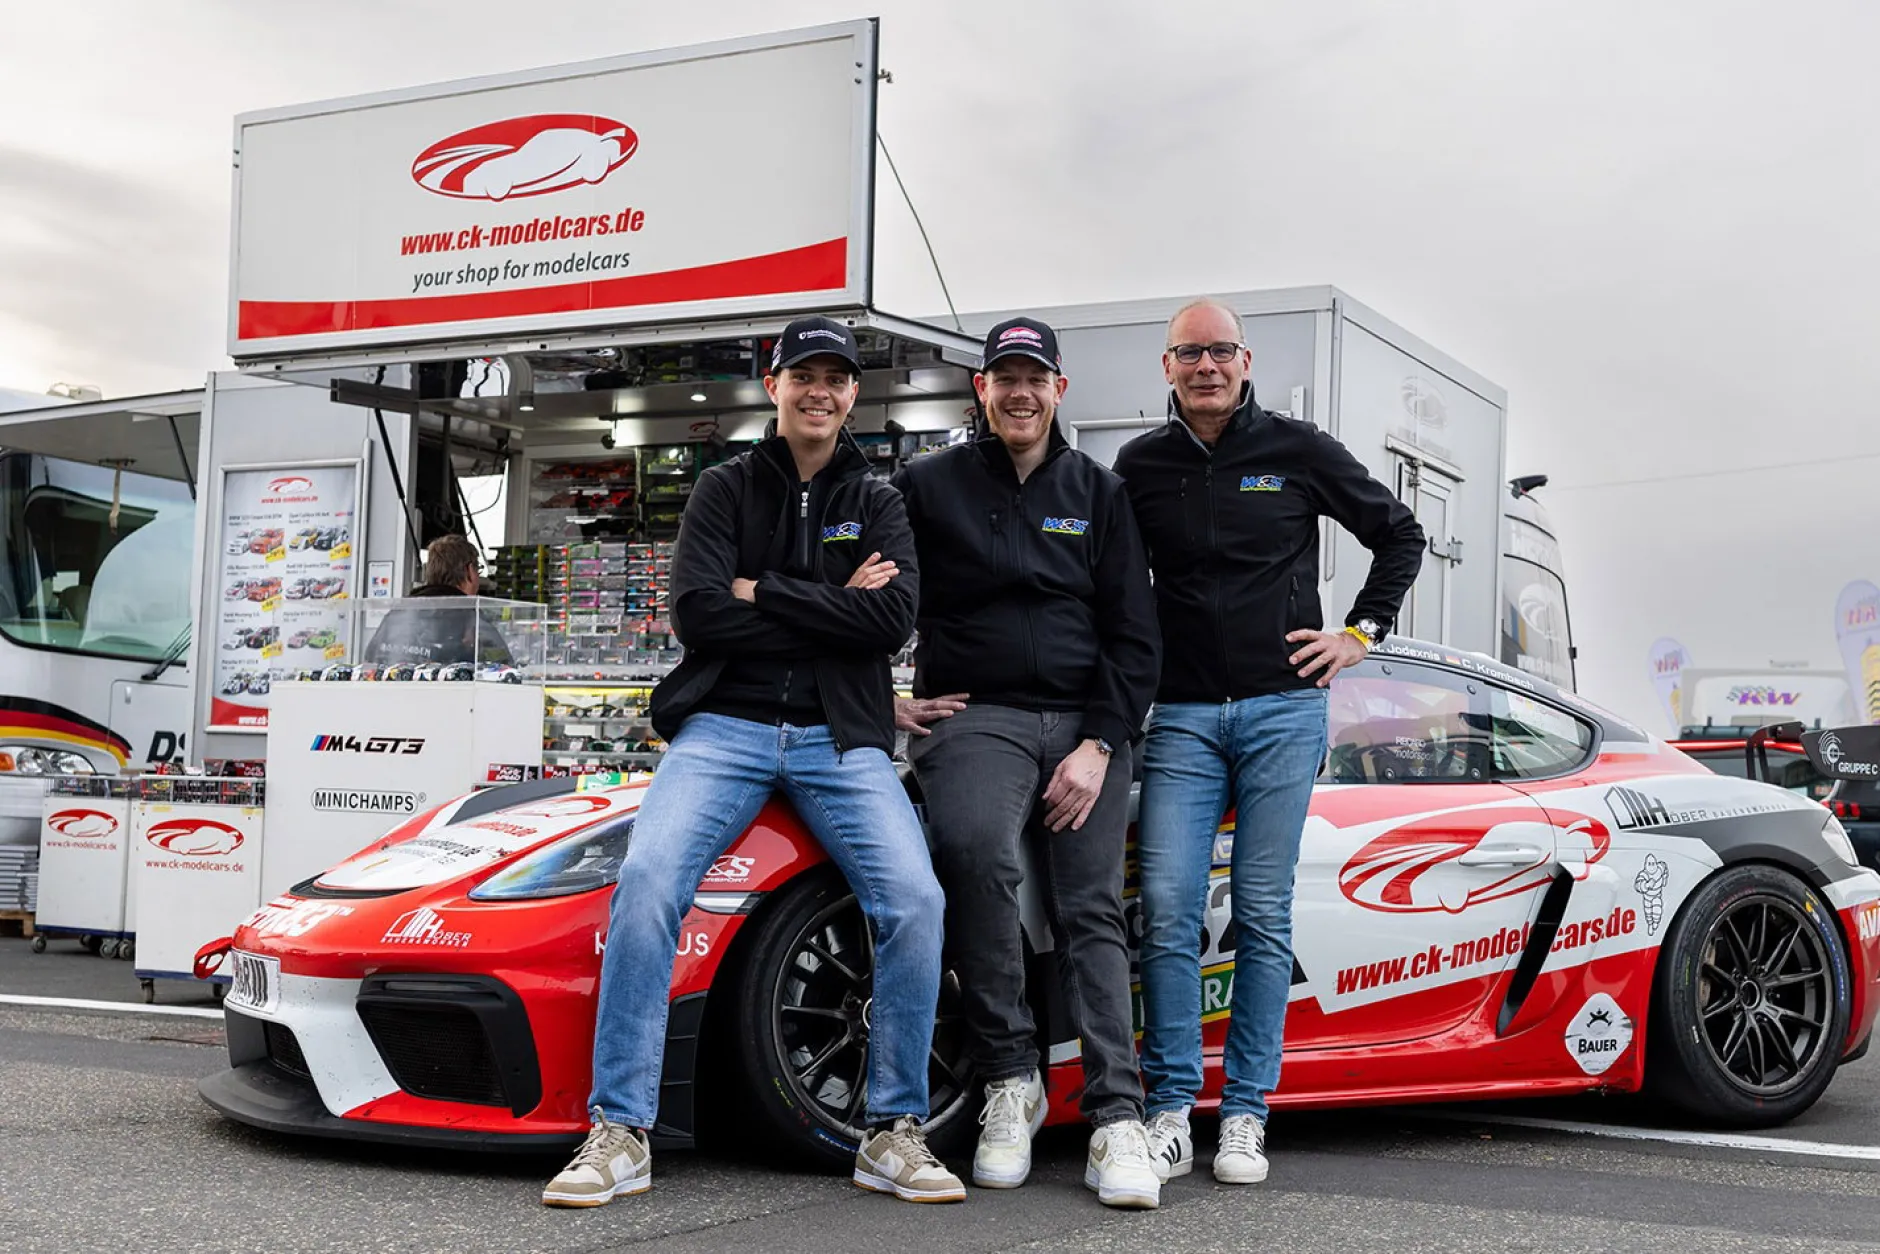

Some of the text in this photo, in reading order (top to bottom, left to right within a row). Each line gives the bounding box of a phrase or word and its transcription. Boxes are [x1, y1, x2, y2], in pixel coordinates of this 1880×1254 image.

[401, 209, 645, 255] www.ck-modelcars.de
[413, 251, 630, 292] your shop for modelcars
[1461, 657, 1474, 668] C.
[364, 738, 426, 754] GT3
[1838, 762, 1871, 774] GRUPPE
[315, 791, 415, 812] MINICHAMPS
[46, 840, 117, 851] www.ck-modelcars.de
[145, 859, 244, 873] www.ck-modelcars.de
[1577, 1038, 1618, 1055] BAUER
